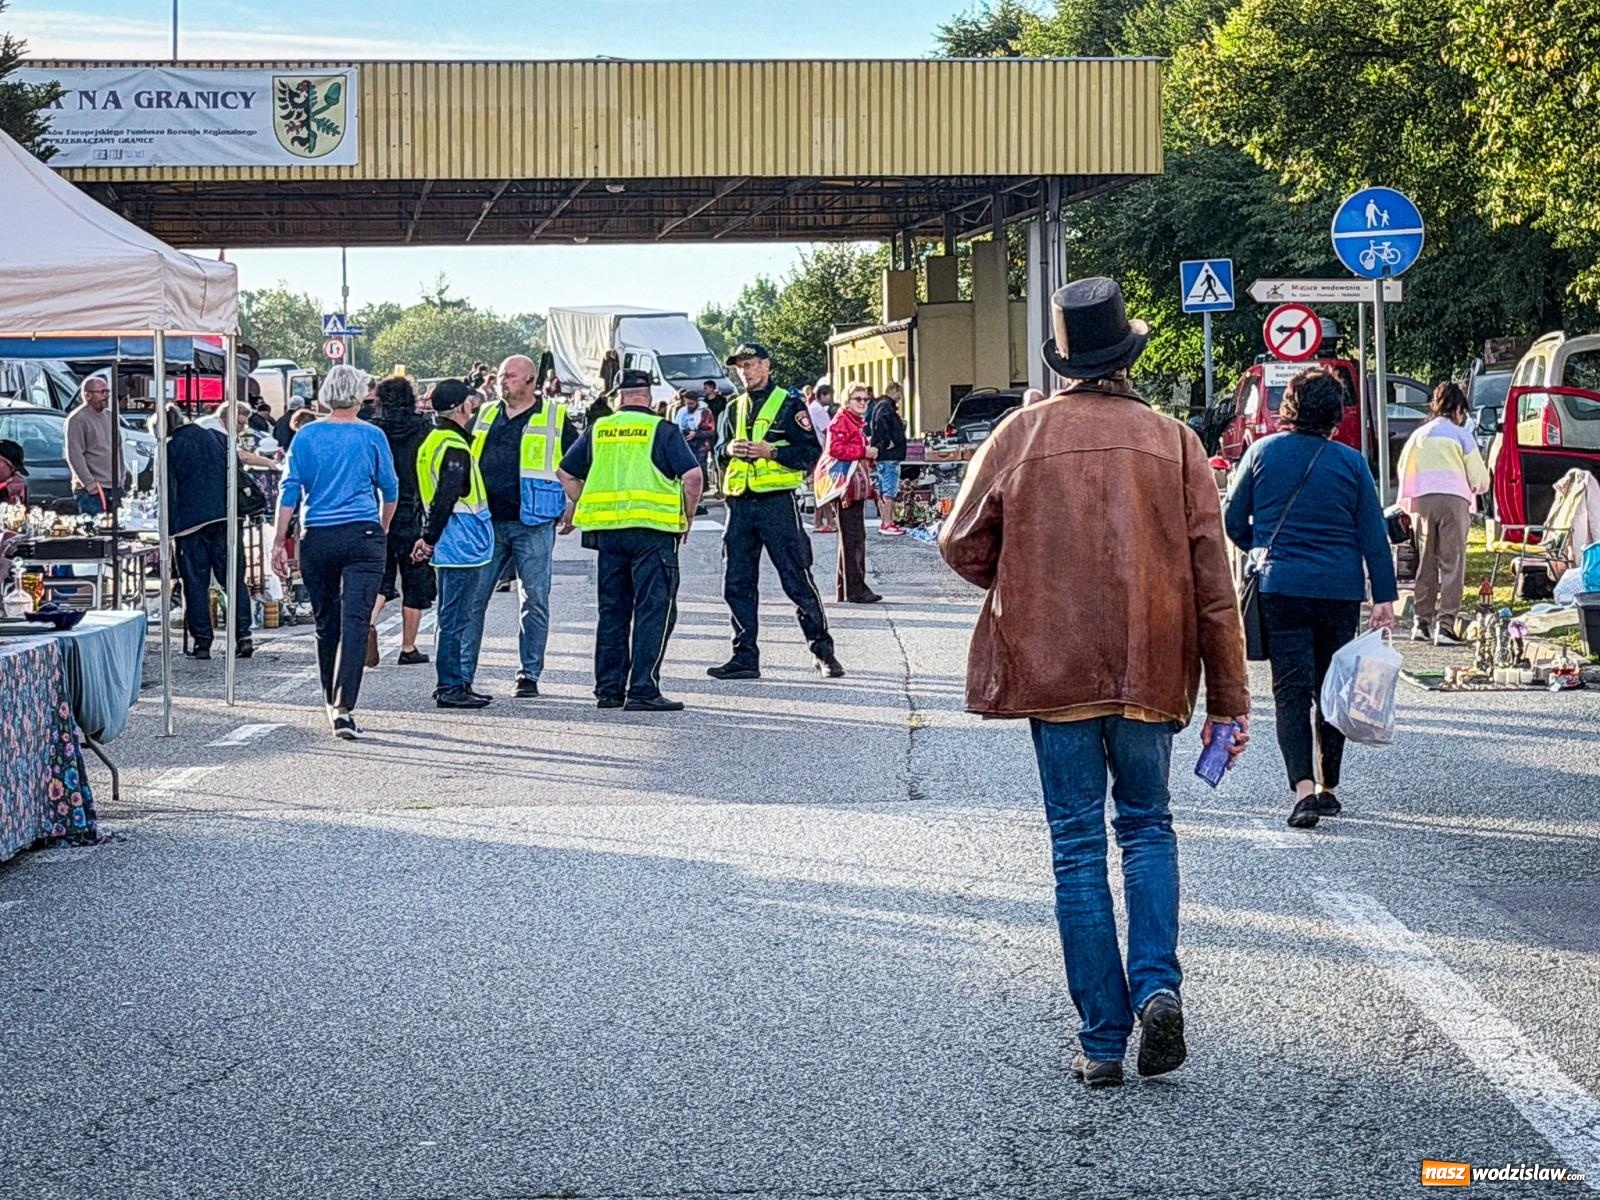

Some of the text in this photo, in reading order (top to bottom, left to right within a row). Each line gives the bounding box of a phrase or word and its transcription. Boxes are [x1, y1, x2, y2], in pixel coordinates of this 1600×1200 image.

[78, 90, 123, 110] NA
[134, 90, 256, 110] GRANICY
[66, 128, 124, 136] Europejskiego
[202, 128, 257, 136] Regionalnego
[1321, 283, 1360, 291] wodowania
[619, 428, 648, 437] MIEJSKA
